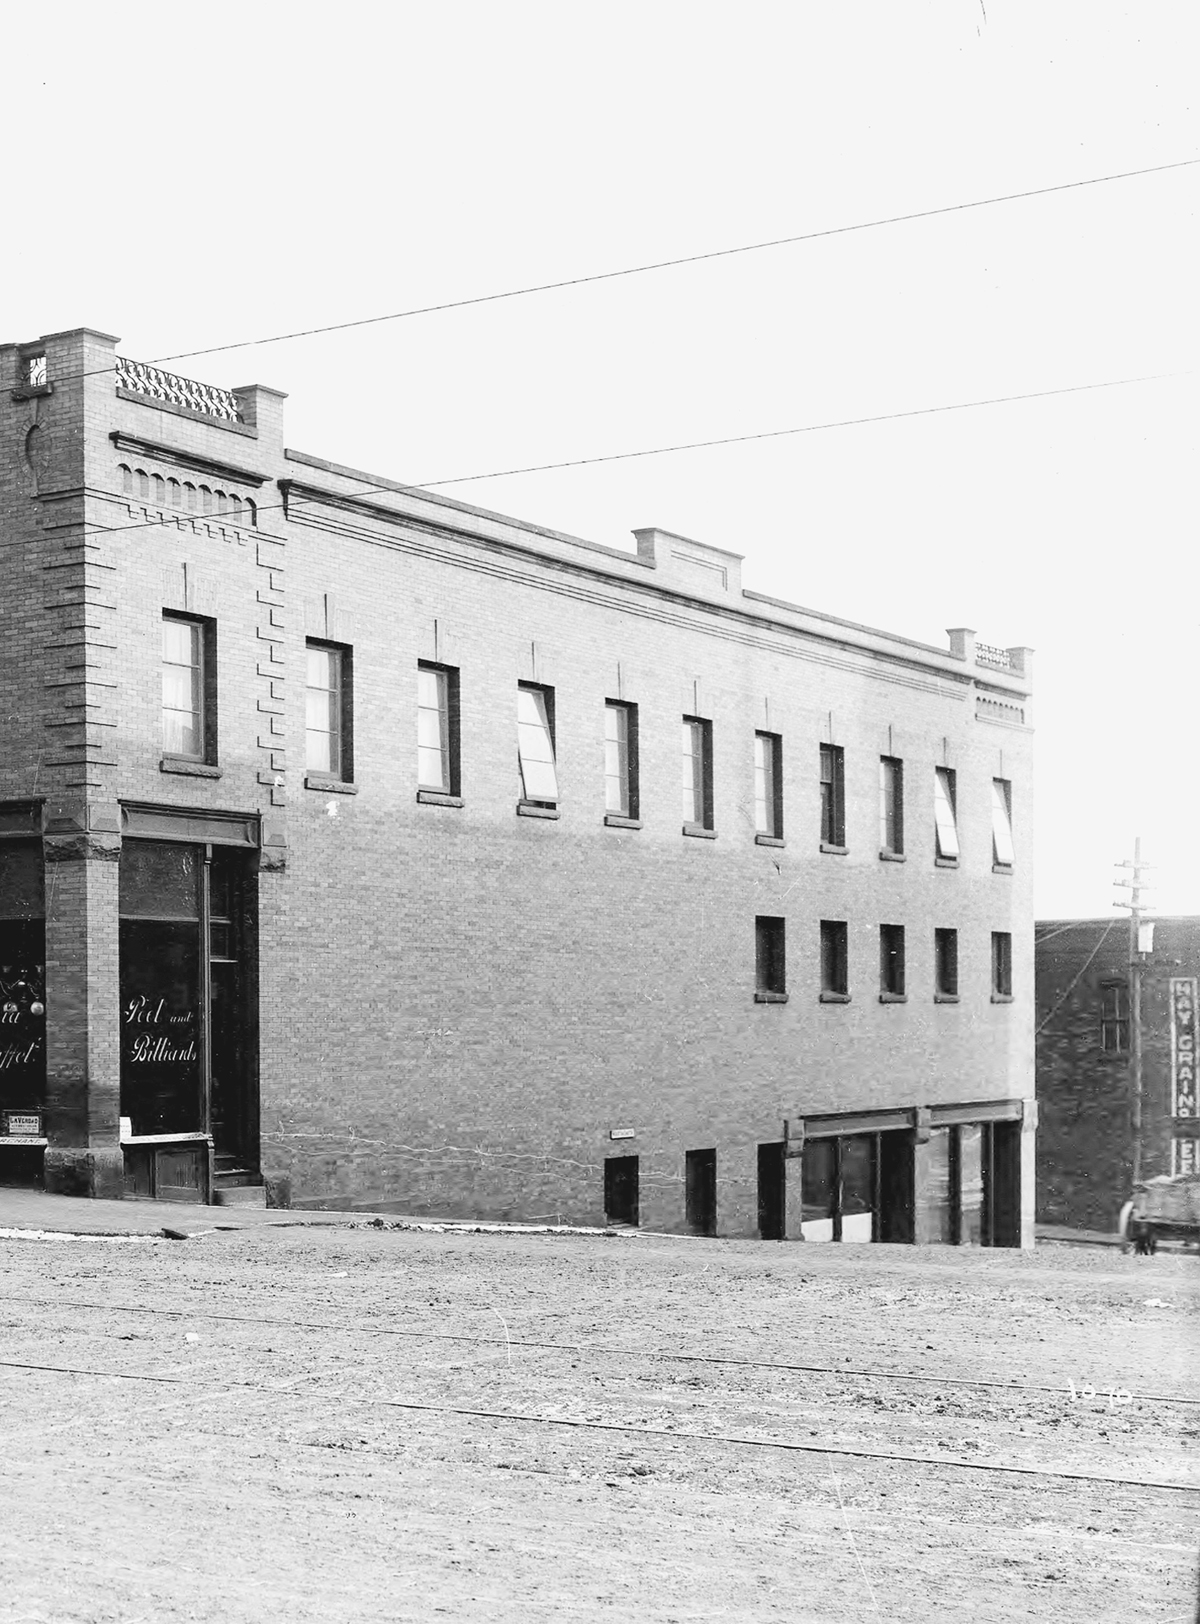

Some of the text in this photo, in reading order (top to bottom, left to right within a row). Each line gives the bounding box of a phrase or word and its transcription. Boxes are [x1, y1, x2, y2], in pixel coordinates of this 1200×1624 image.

[170, 1011, 194, 1022] and
[1175, 982, 1193, 1025] HAY
[131, 1034, 197, 1062] Billiards
[1177, 1035, 1194, 1108] GRAIN
